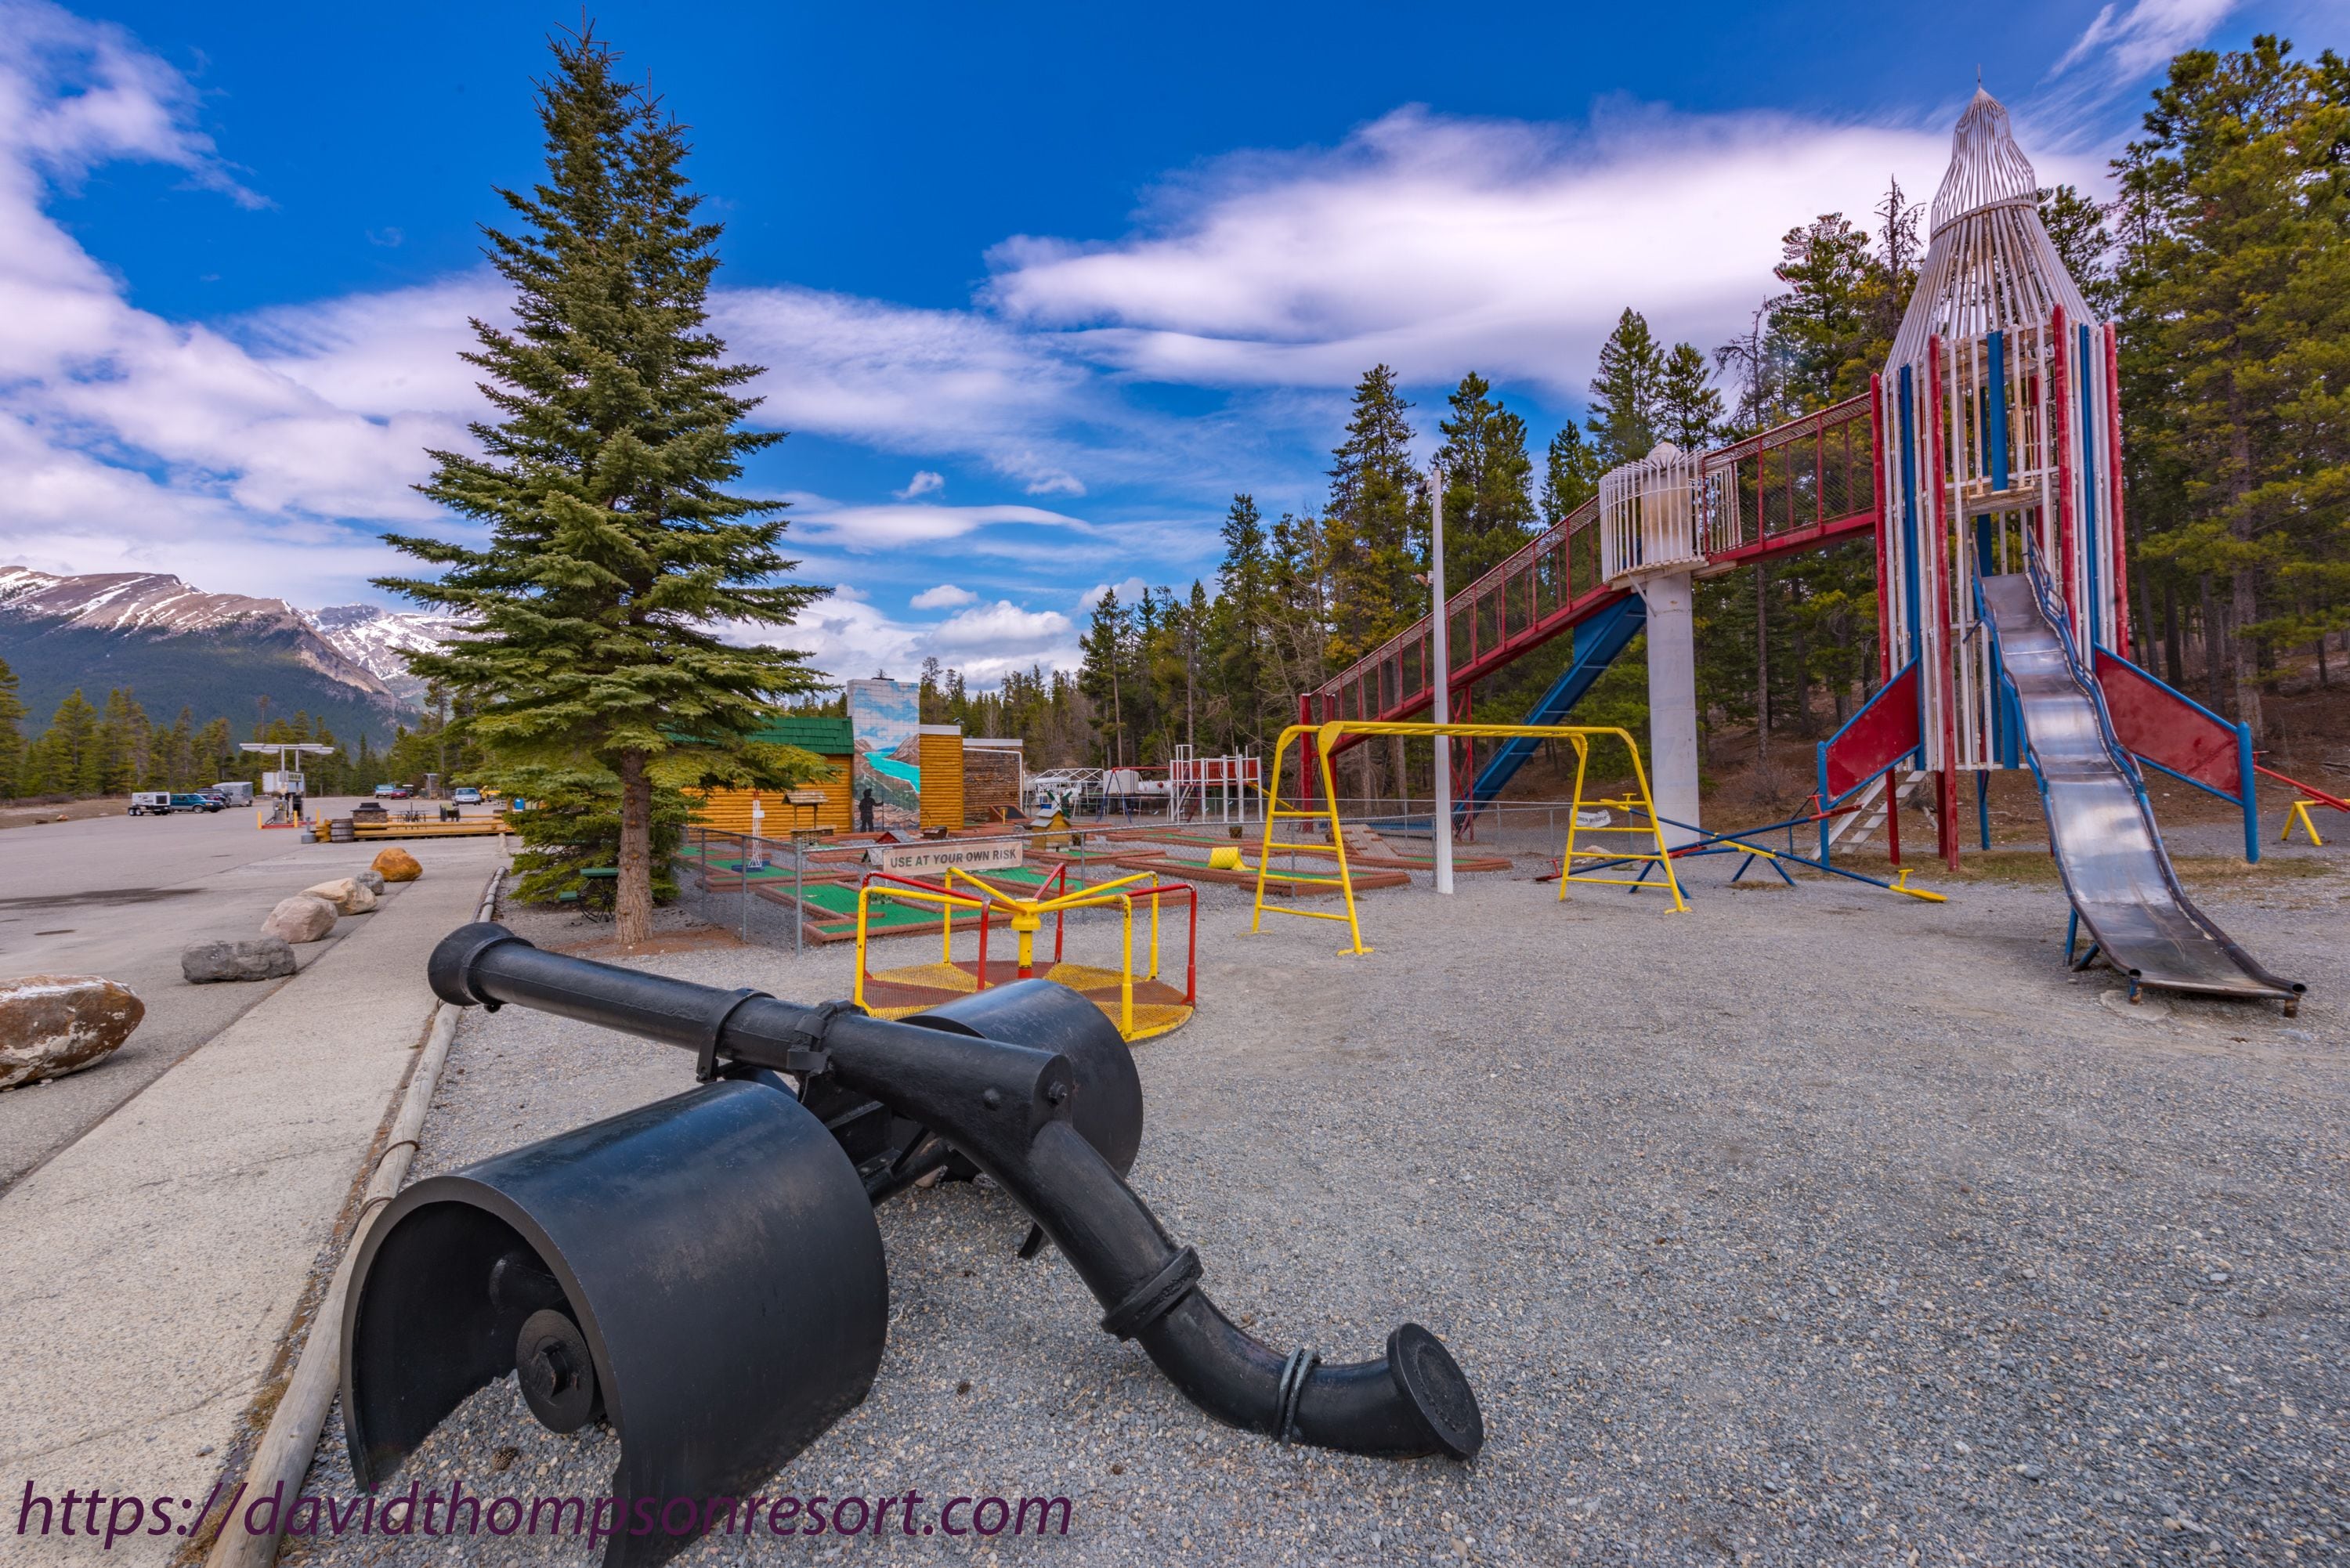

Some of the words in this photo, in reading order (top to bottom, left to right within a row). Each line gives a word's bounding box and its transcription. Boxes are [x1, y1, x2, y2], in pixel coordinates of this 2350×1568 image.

[890, 856, 913, 869] USE
[915, 854, 930, 867] AT
[934, 852, 964, 864] YOUR
[966, 850, 989, 862] OWN
[992, 848, 1017, 861] RISK
